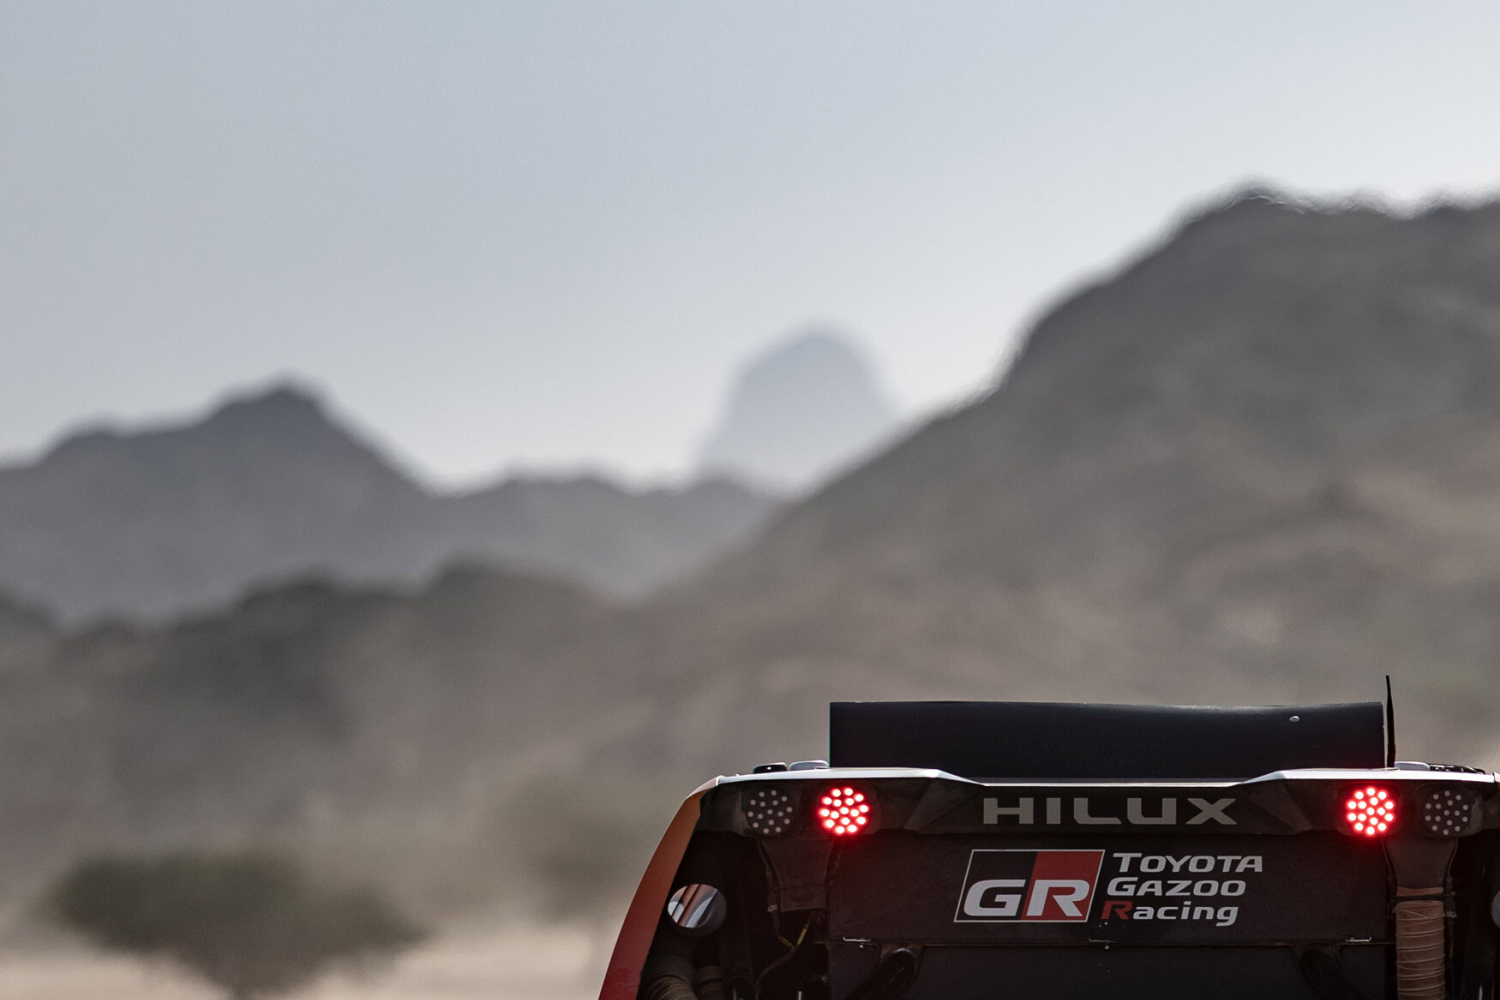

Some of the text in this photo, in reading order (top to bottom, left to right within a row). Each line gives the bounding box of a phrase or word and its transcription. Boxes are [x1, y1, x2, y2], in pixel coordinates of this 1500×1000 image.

[983, 797, 1237, 825] HILUX
[1112, 852, 1264, 873] TOYOTA
[963, 879, 1091, 917] GR
[1106, 876, 1247, 897] GAZOO
[1100, 900, 1239, 927] Racing
